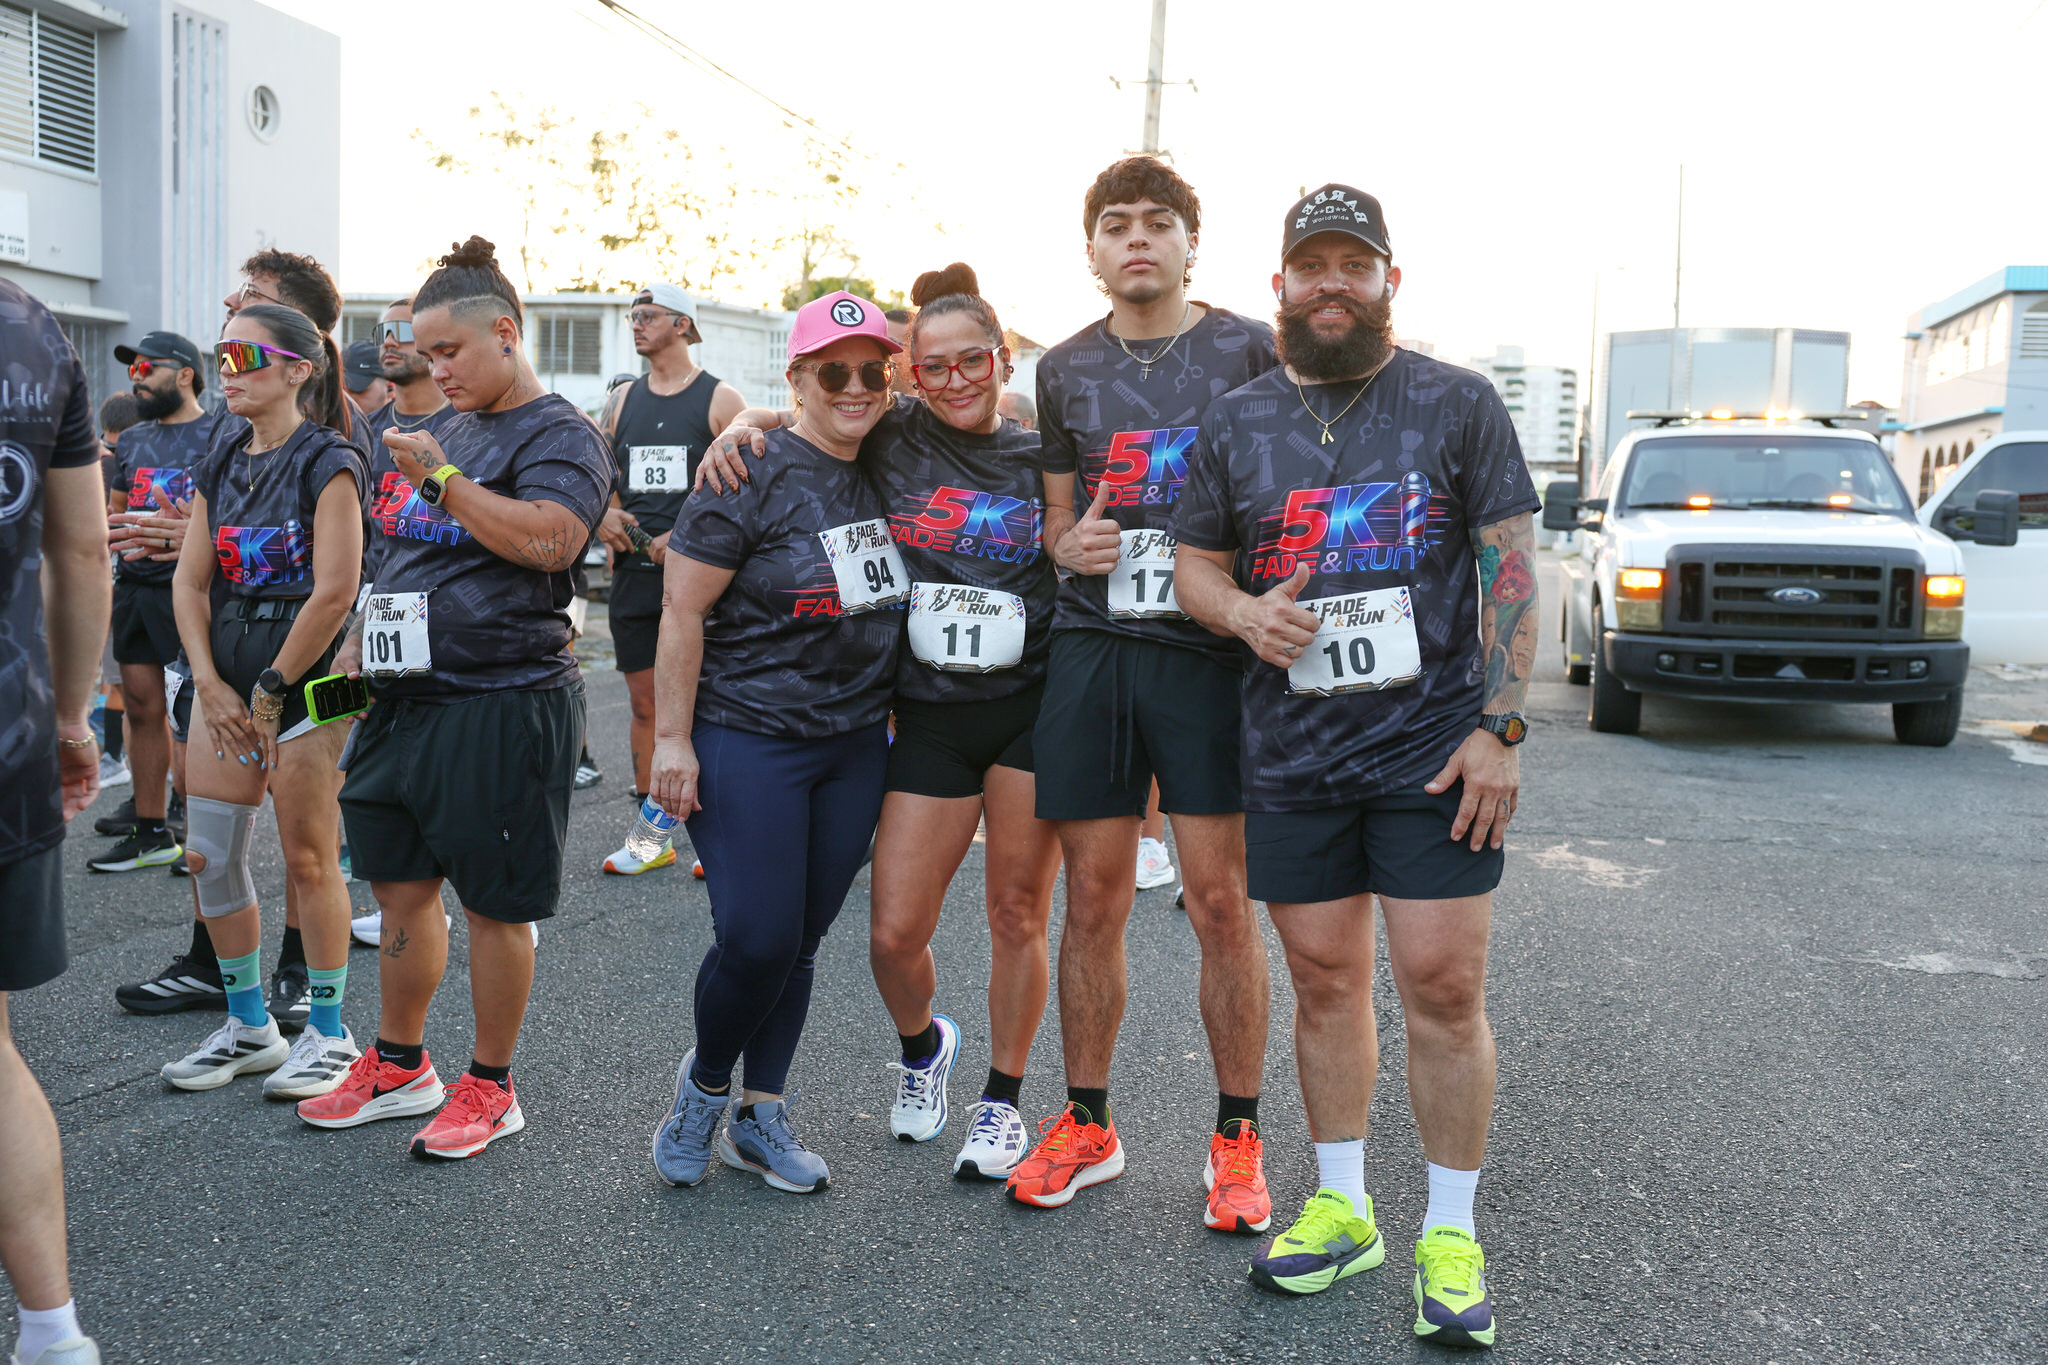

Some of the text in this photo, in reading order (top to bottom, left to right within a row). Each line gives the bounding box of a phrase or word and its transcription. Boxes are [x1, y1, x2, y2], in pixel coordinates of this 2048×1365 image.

[646, 448, 666, 457] FADE
[656, 455, 674, 463] RUN
[1101, 427, 1199, 486] 5K
[129, 467, 184, 498] 5K
[644, 467, 667, 485] 83
[1142, 485, 1163, 504] &
[913, 485, 1028, 543] 5K
[1277, 482, 1399, 553] 5K
[396, 519, 408, 537] &
[409, 519, 460, 546] RUN
[855, 523, 878, 540] FADE
[1148, 533, 1178, 548] FAD
[216, 526, 282, 571] 5K
[864, 536, 889, 549] & RUN
[890, 524, 1040, 566] FADE & RUN
[1157, 547, 1167, 558] &
[1251, 546, 1415, 582] FADE & RUN
[242, 570, 254, 585] &
[863, 556, 895, 593] 94
[948, 588, 990, 603] FADE
[1131, 568, 1174, 603] 17
[372, 597, 394, 610] FADE
[957, 603, 1002, 616] & RUN
[1320, 596, 1368, 617] FADE
[381, 609, 406, 622] RUN
[1334, 609, 1385, 628] & RUN
[368, 630, 403, 664] 101
[942, 623, 982, 658] 11
[1323, 637, 1376, 678] 10
